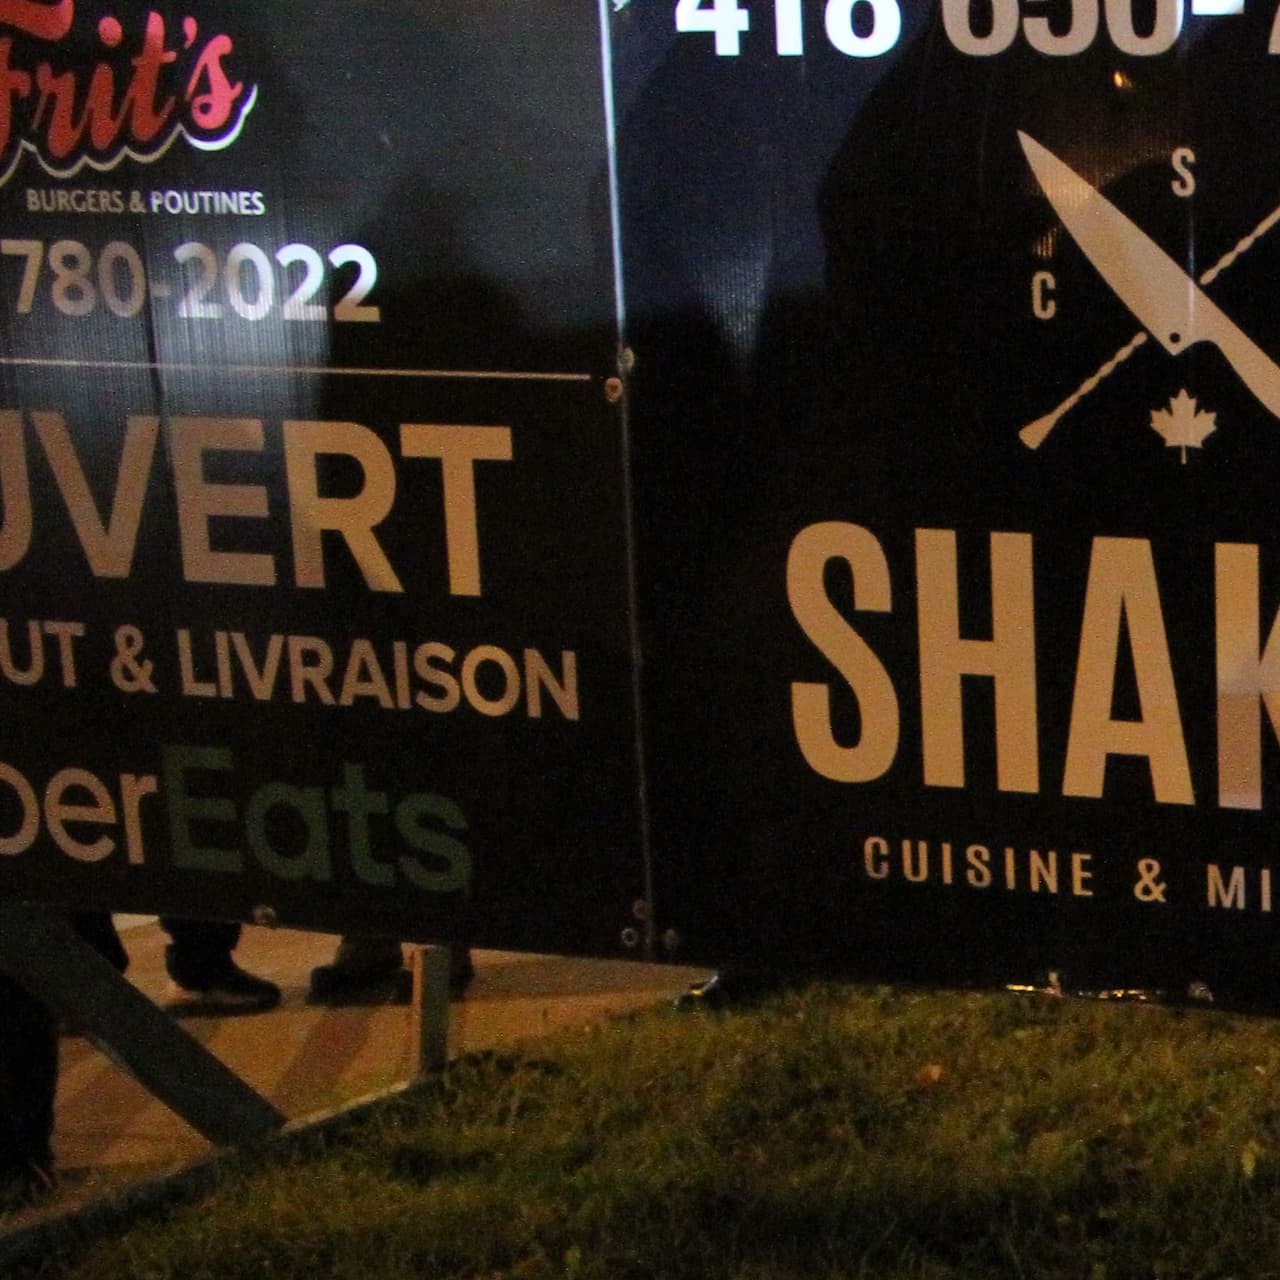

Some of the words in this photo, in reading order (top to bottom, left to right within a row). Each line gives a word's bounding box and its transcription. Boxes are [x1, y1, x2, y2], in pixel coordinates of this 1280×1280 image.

[27, 188, 124, 213] BURGERS
[129, 190, 147, 213] &
[151, 190, 266, 215] POUTINES
[1171, 147, 1196, 198] S
[1, 239, 381, 322] 780-2022
[1031, 271, 1056, 320] C
[110, 624, 159, 693] &
[177, 628, 579, 720] LIVRAISON
[864, 836, 1093, 897] CUISINE
[1133, 857, 1167, 903] &
